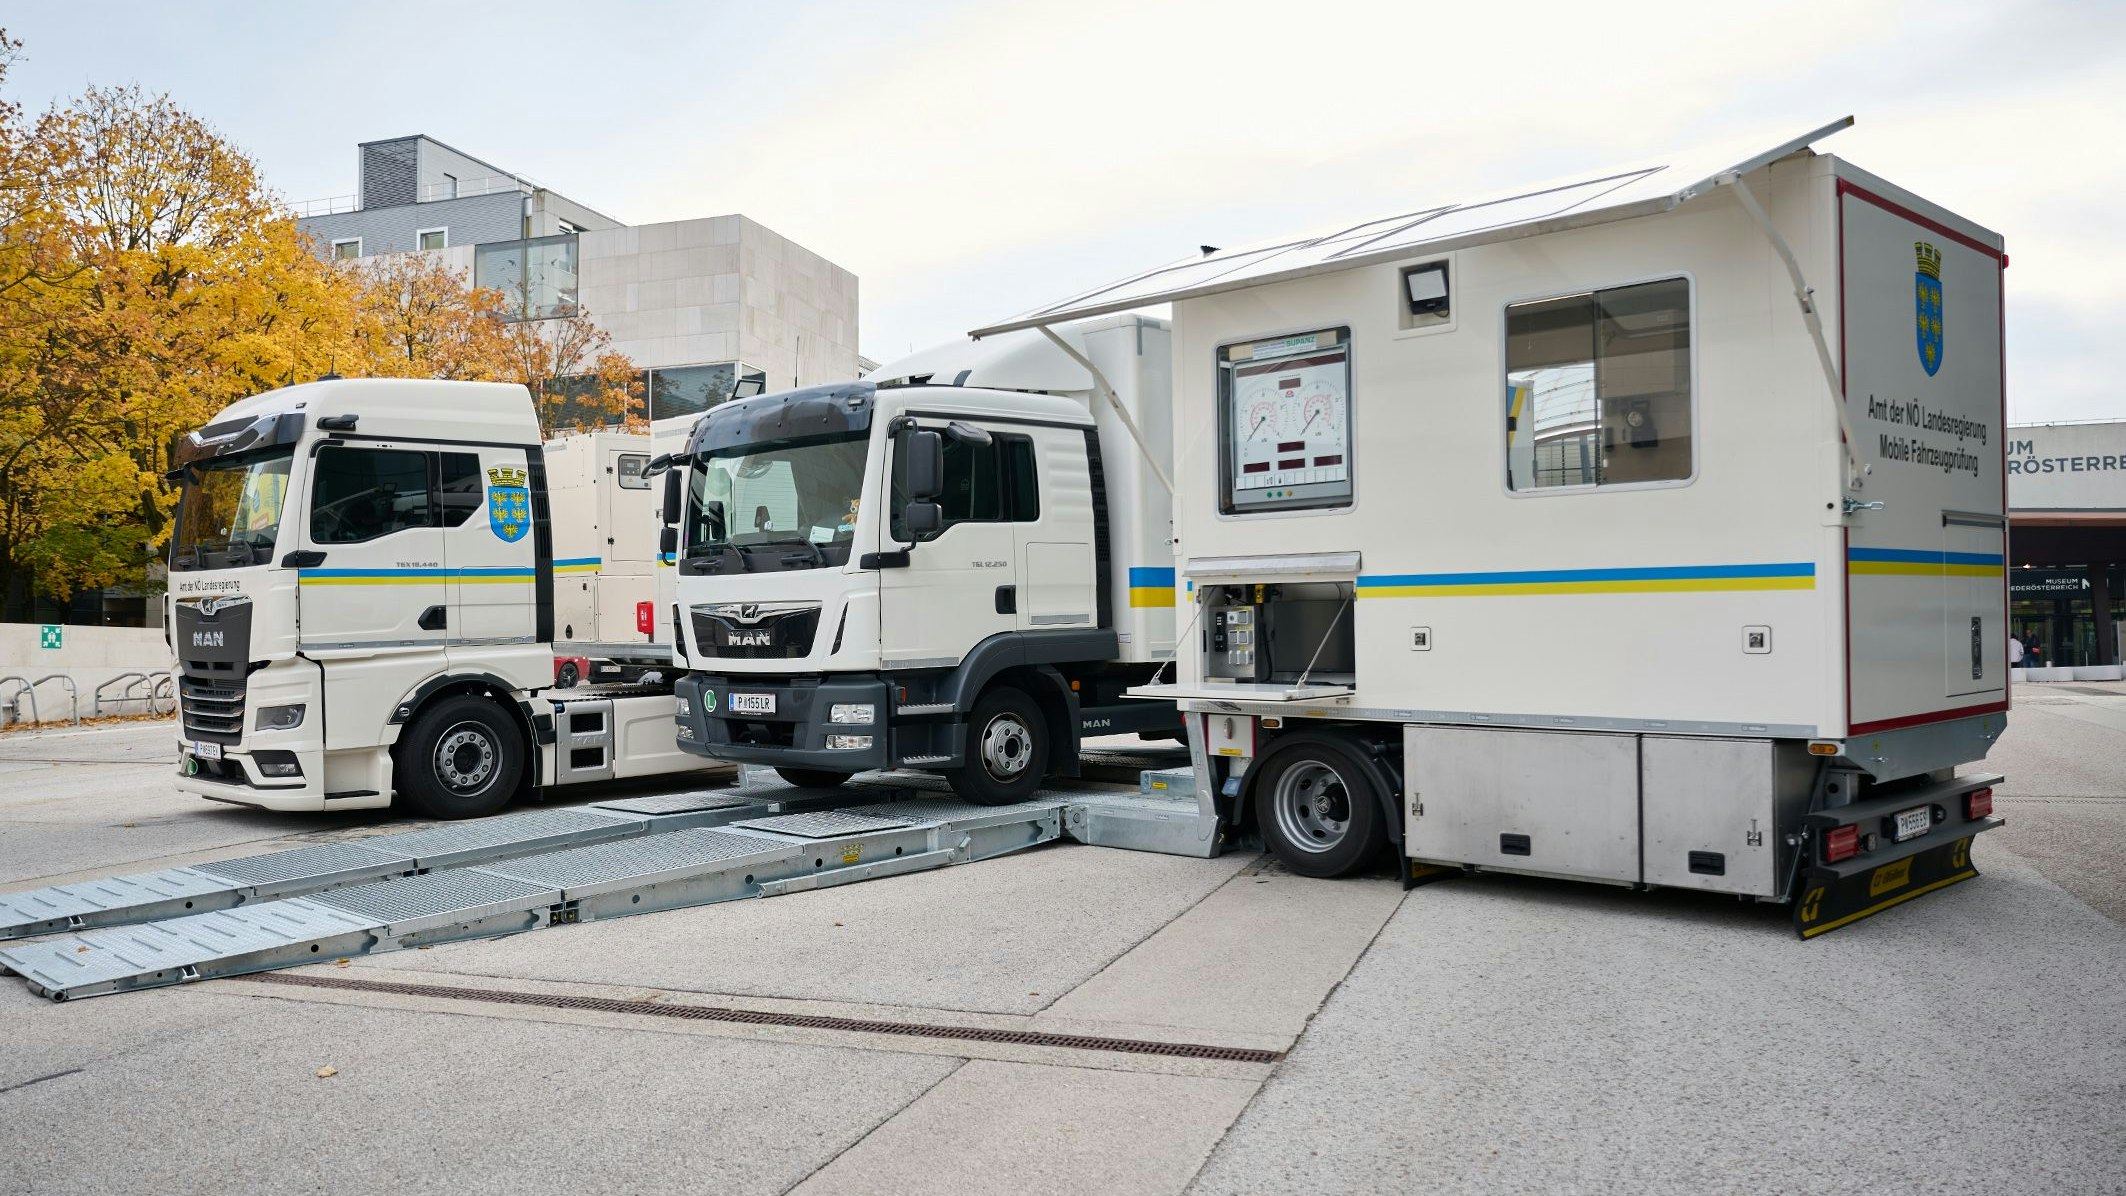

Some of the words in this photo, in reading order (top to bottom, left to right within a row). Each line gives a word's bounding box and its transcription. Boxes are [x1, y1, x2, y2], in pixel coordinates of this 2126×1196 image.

[1868, 394, 1888, 421] Amt
[1889, 400, 1904, 424] der
[1906, 398, 1920, 427] NÖ
[1922, 405, 1987, 446] Landesregierung
[1880, 434, 1909, 461] Mobile
[1911, 439, 1978, 477] Fahrzeugprüfung
[193, 631, 224, 647] MAN
[728, 631, 771, 646] MAN
[1082, 718, 1111, 729] MAN
